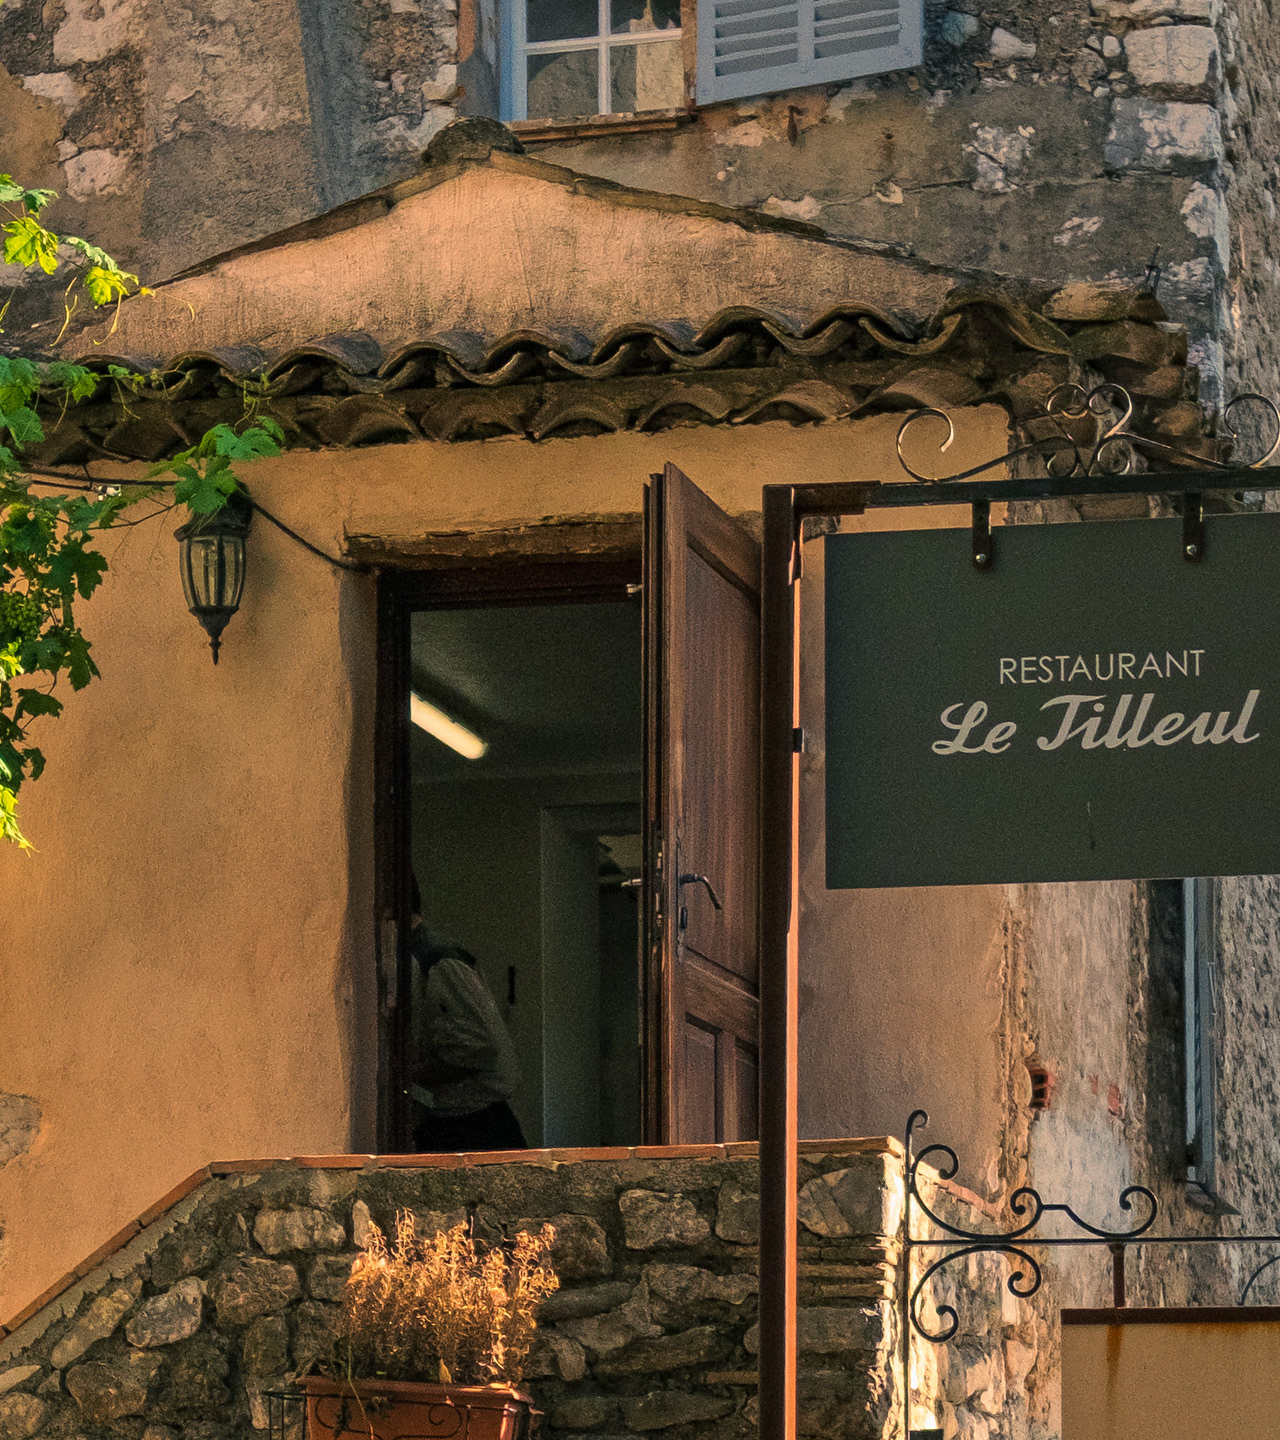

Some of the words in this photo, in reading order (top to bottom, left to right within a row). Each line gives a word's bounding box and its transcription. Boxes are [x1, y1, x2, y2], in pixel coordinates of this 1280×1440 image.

[999, 649, 1206, 685] RESTAURANT
[931, 700, 1018, 755] Le
[1036, 689, 1261, 751] Tilleul
